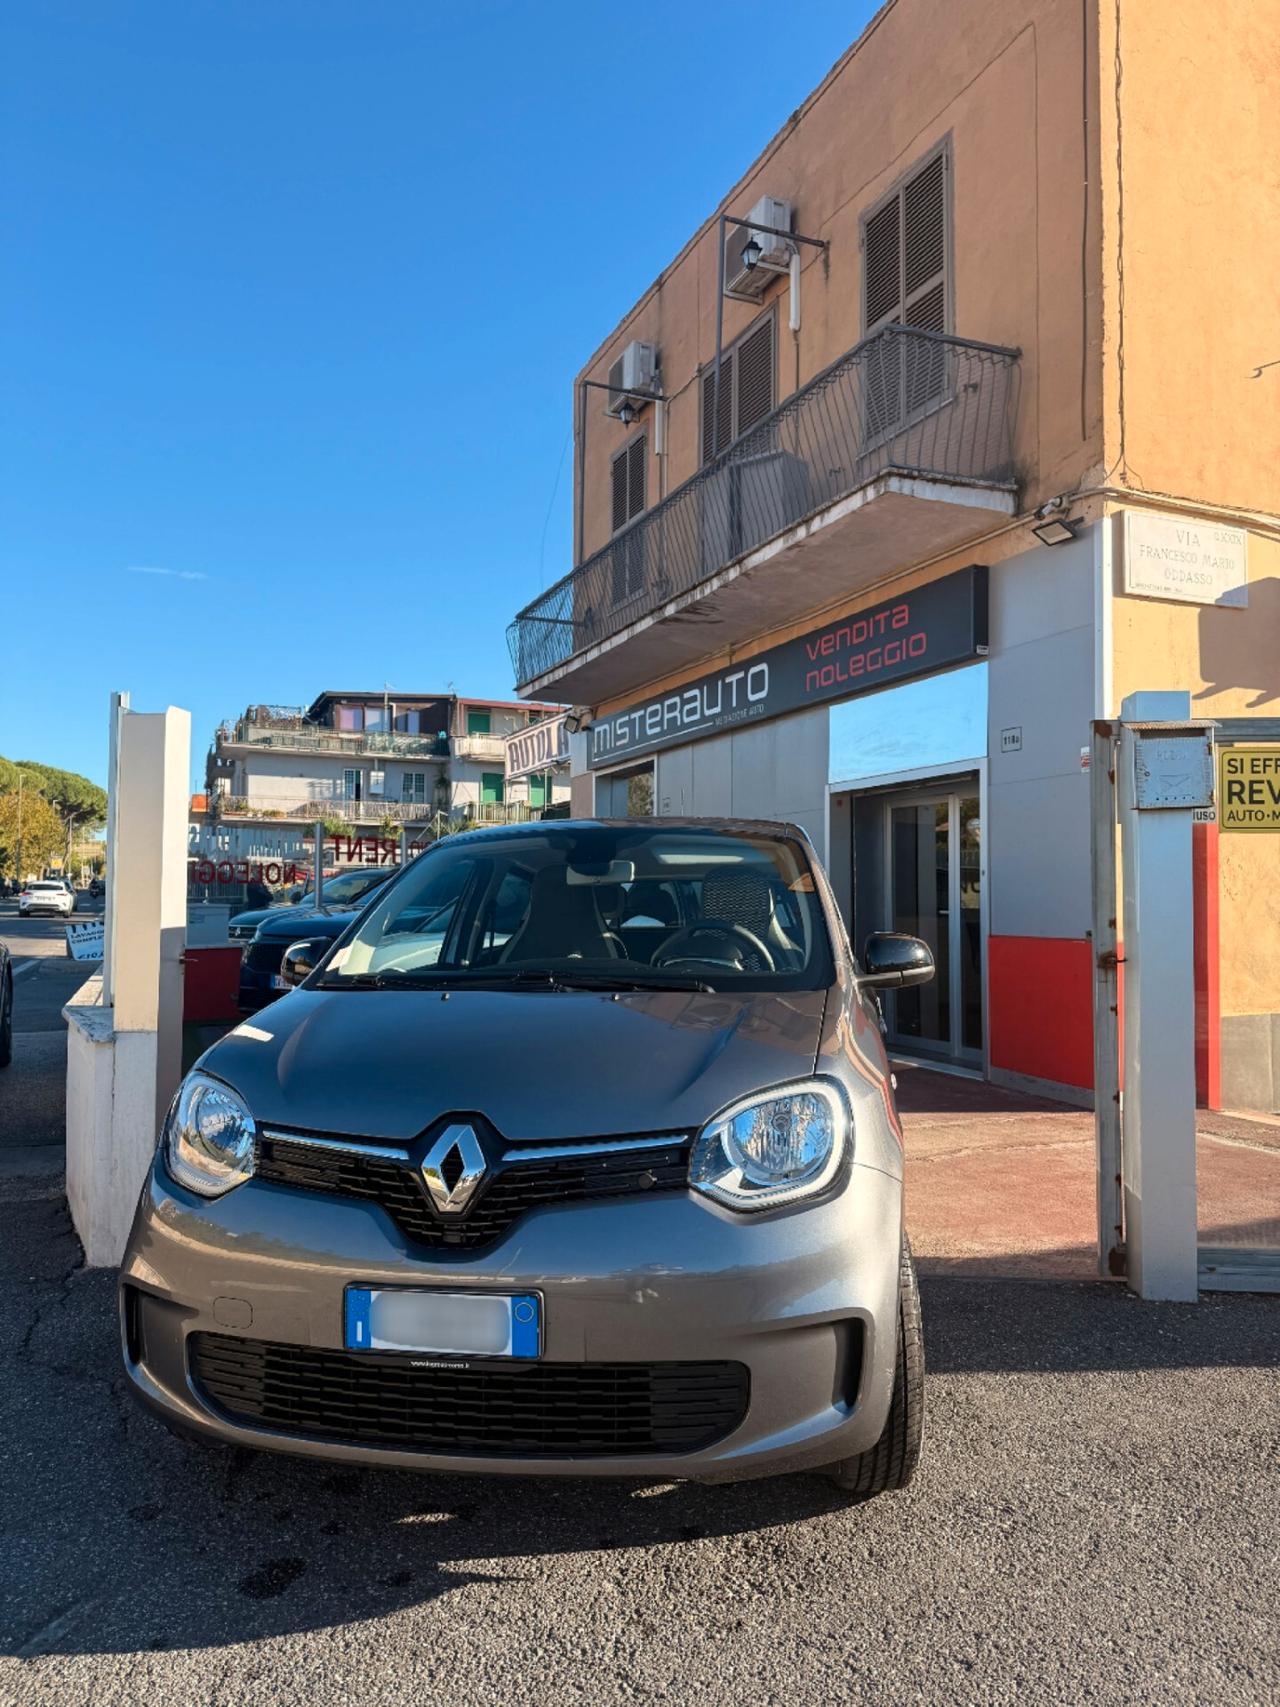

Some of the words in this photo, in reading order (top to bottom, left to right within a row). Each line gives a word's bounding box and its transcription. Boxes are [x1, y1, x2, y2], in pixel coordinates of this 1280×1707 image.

[1176, 529, 1201, 547] VIA
[1139, 544, 1198, 564] FRANCESCO
[1202, 554, 1235, 570] MARIO
[1164, 567, 1213, 585] ODDASSO
[1227, 758, 1244, 774] SI
